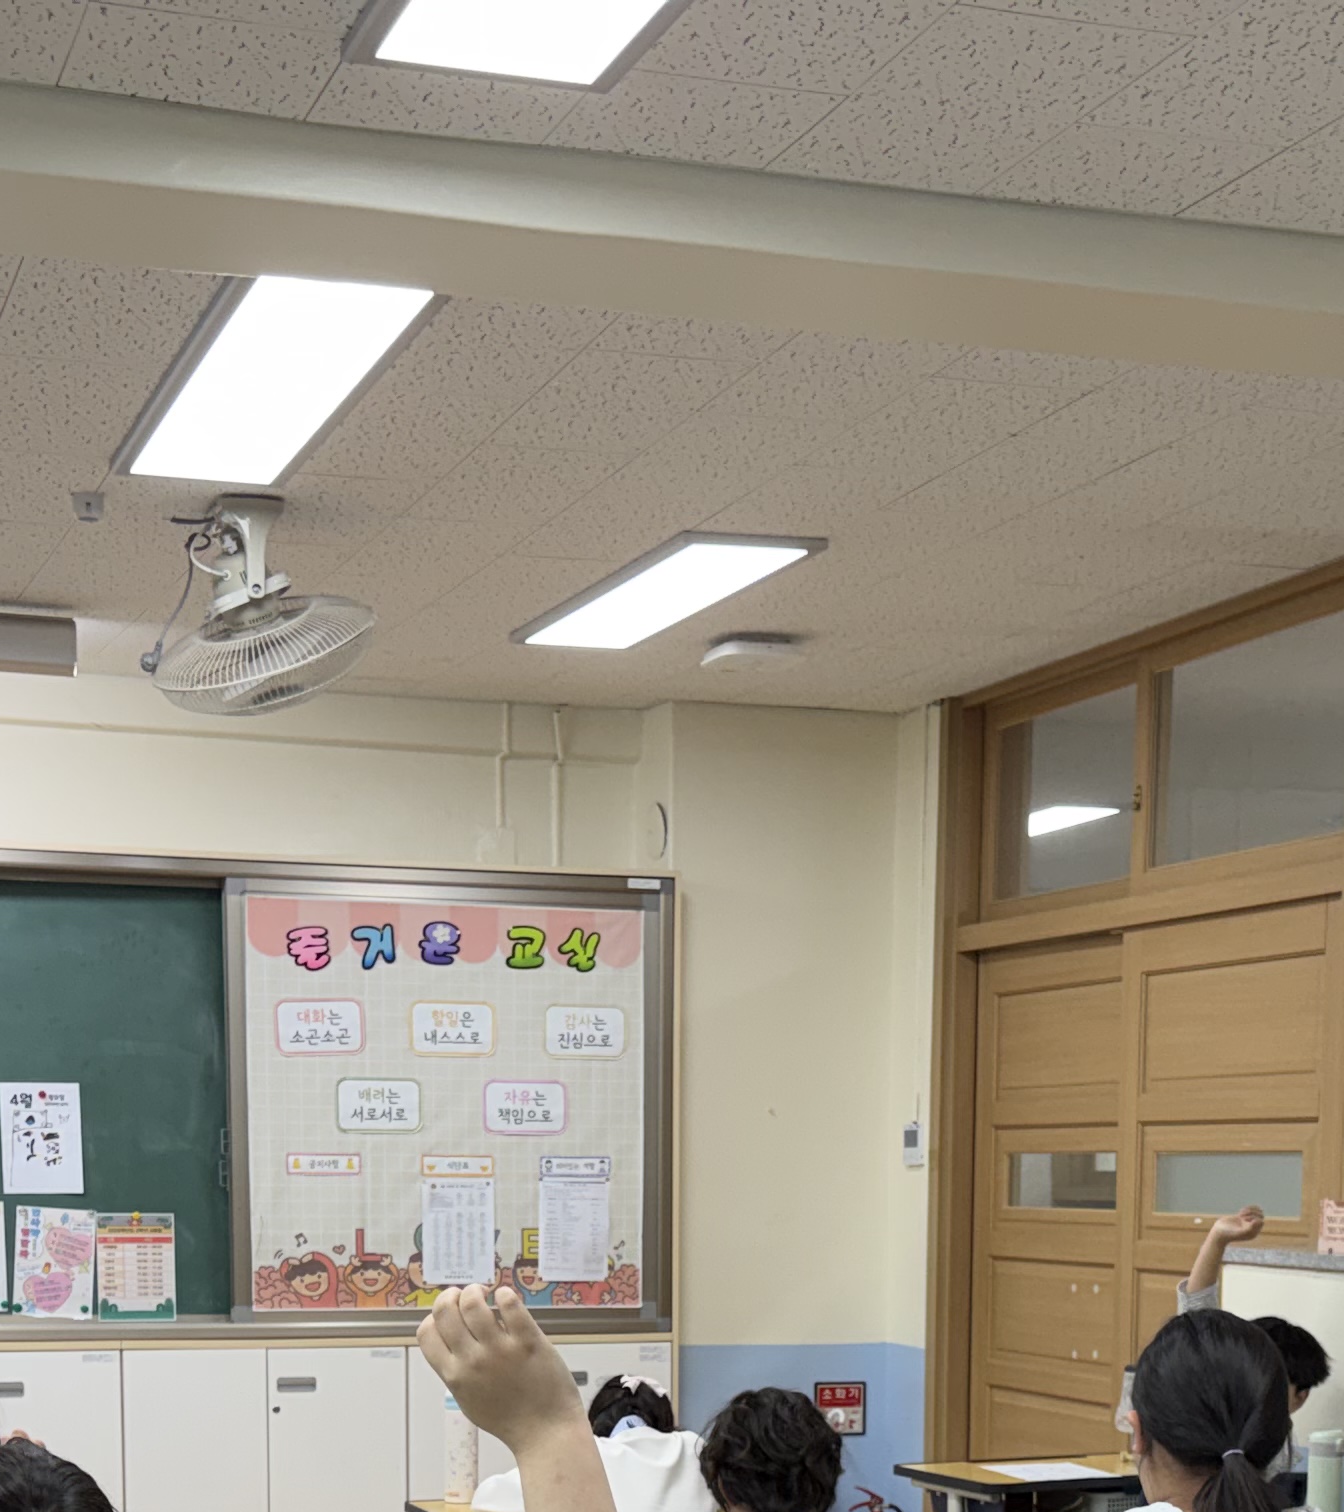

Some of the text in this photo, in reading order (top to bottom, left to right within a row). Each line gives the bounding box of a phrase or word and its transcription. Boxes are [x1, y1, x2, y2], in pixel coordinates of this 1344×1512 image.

[286, 921, 600, 972] 즐거운 교실
[296, 1008, 343, 1026] 대화는
[564, 1013, 607, 1031] 감사는
[289, 1028, 351, 1046] 소곤소곤
[423, 1031, 483, 1046] 내스스로
[557, 1032, 613, 1049] 진심으로
[357, 1087, 401, 1105] 배려는
[504, 1089, 547, 1107] 자유는
[351, 1106, 408, 1123] 서로서로
[497, 1108, 554, 1125] 책임으로
[821, 1387, 860, 1400] 소화기
